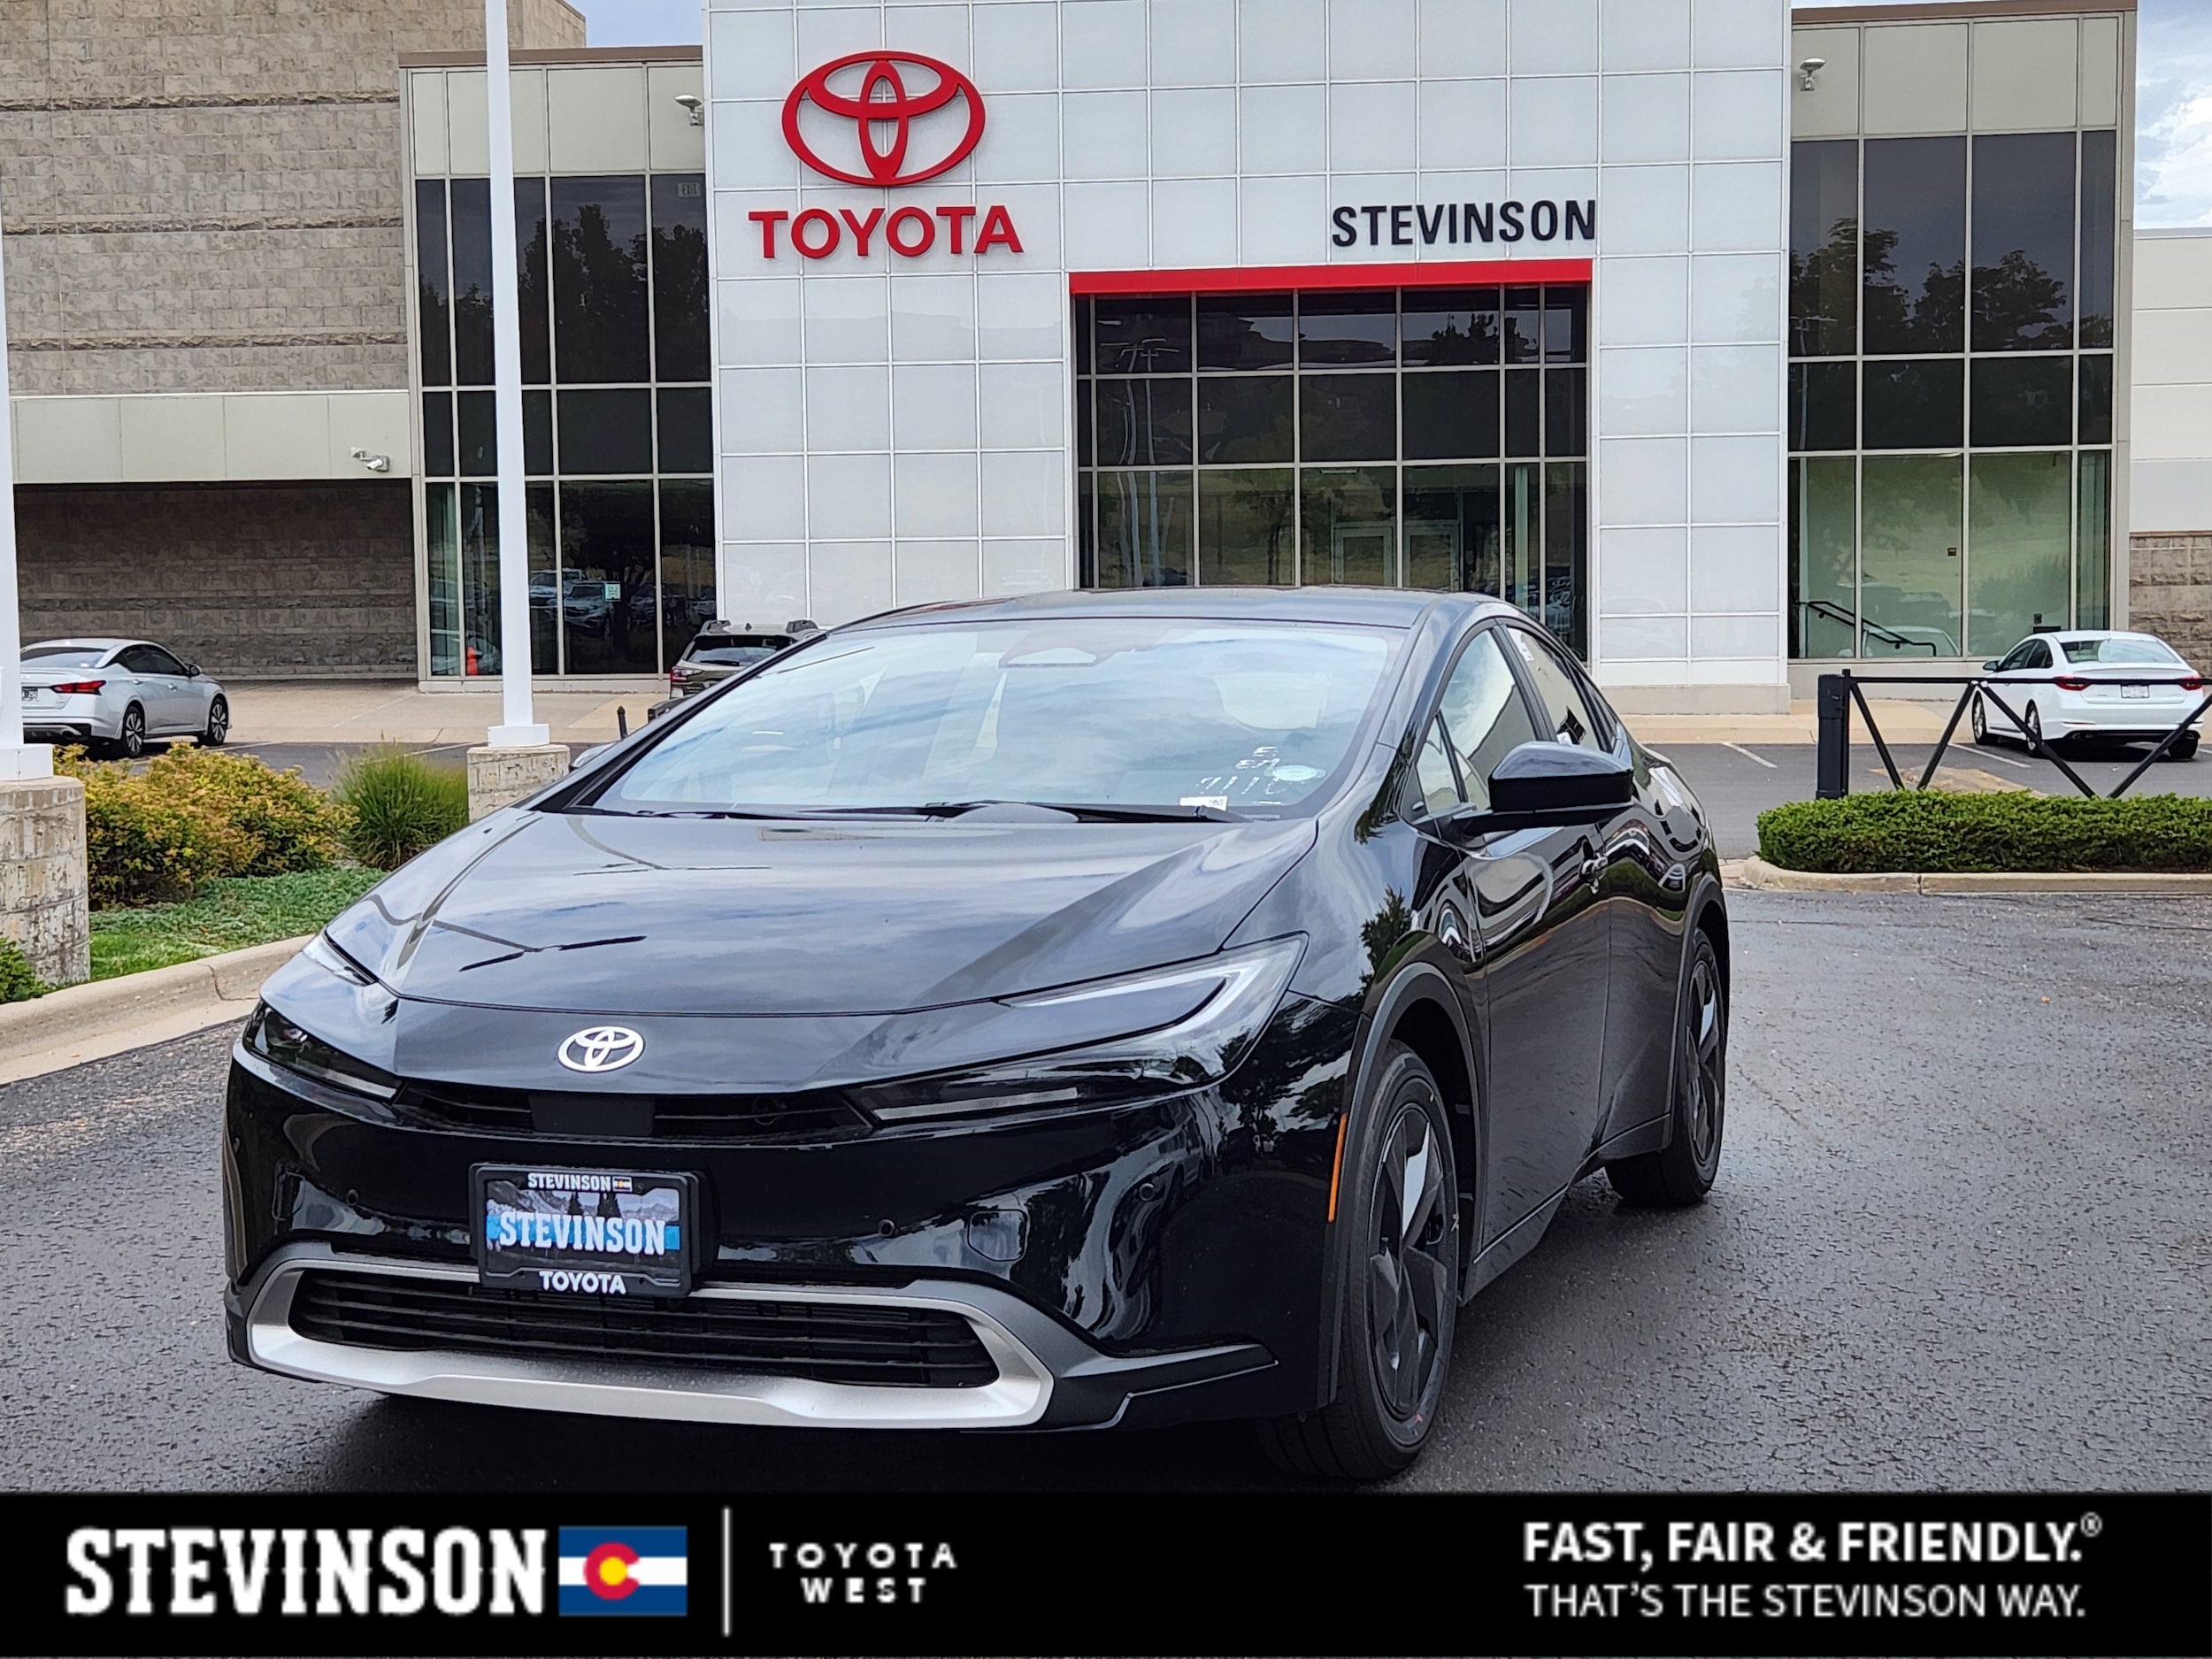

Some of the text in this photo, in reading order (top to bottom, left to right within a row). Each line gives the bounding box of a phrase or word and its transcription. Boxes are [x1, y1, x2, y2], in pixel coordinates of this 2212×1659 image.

[749, 205, 1024, 259] TOYOTA
[1332, 200, 1595, 247] STEVINSON
[527, 1172, 612, 1192] STEVINSON
[499, 1211, 665, 1256] STEVINSON
[539, 1271, 626, 1295] TOYOTA
